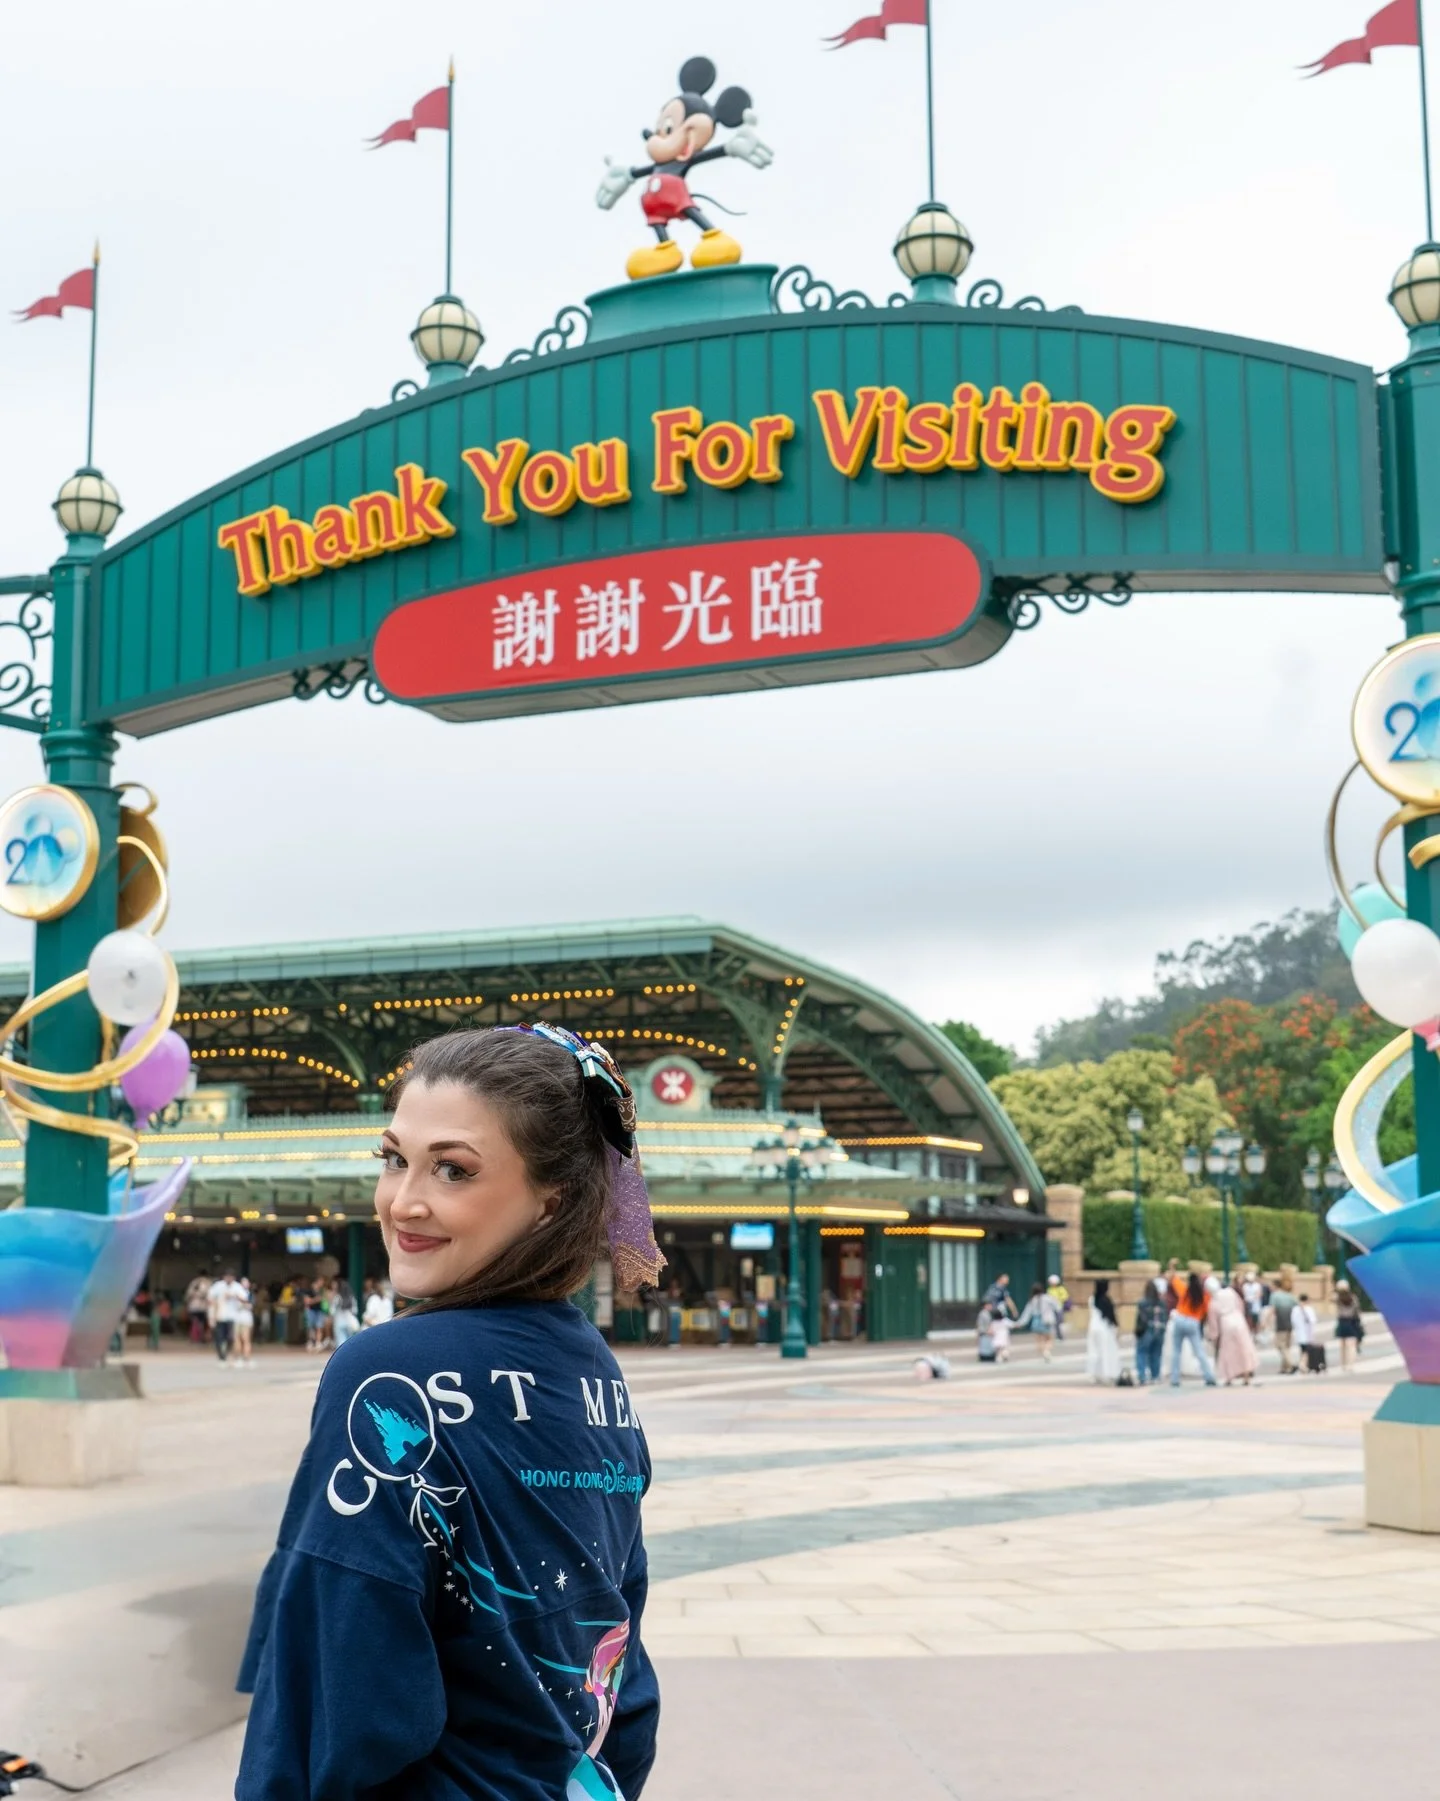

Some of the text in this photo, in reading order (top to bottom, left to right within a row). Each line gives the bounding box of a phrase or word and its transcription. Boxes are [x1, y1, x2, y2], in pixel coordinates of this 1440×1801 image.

[218, 381, 1176, 596] Thank You For Visiting
[491, 557, 823, 671] 謝謝光臨
[520, 1469, 570, 1488] HONG
[573, 1471, 603, 1489] KONG
